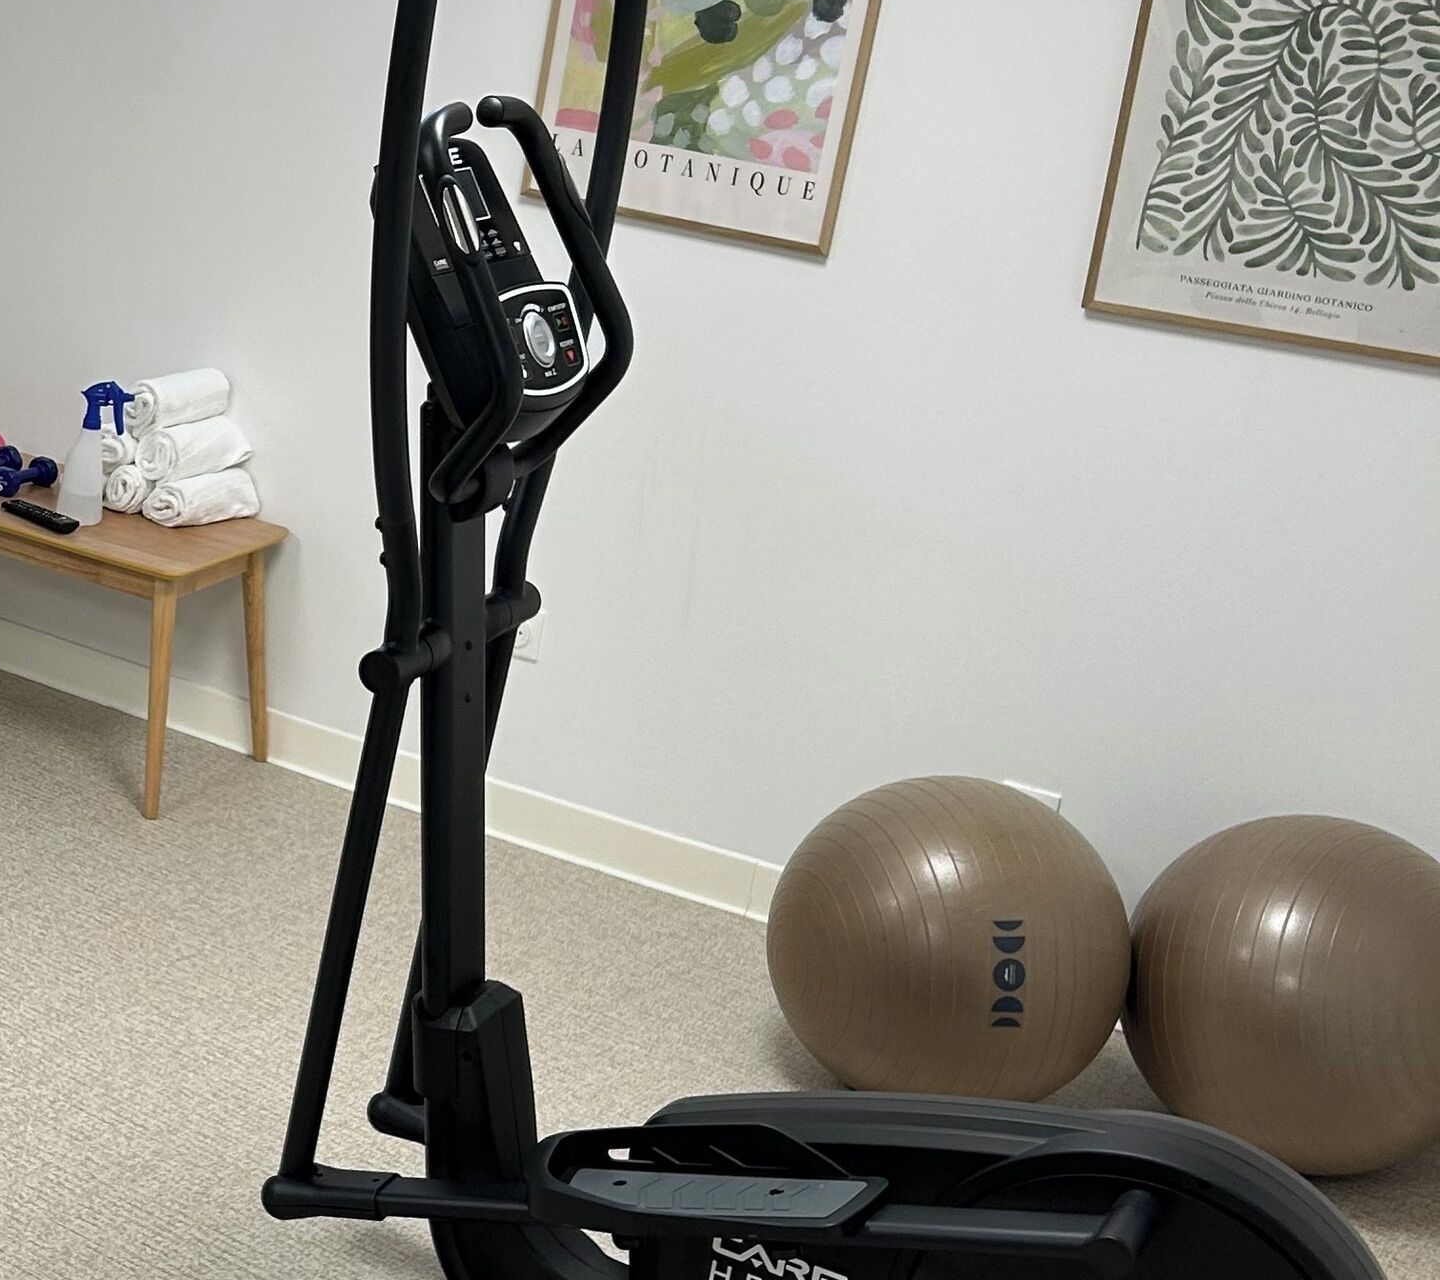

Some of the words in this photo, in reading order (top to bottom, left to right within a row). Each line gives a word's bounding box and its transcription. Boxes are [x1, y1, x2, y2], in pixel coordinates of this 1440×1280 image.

[634, 148, 816, 201] OTANIQUE
[1179, 274, 1254, 295] PASSEGGIATA
[1256, 286, 1311, 304] GIARDINO
[1314, 295, 1374, 313] BOTANICO
